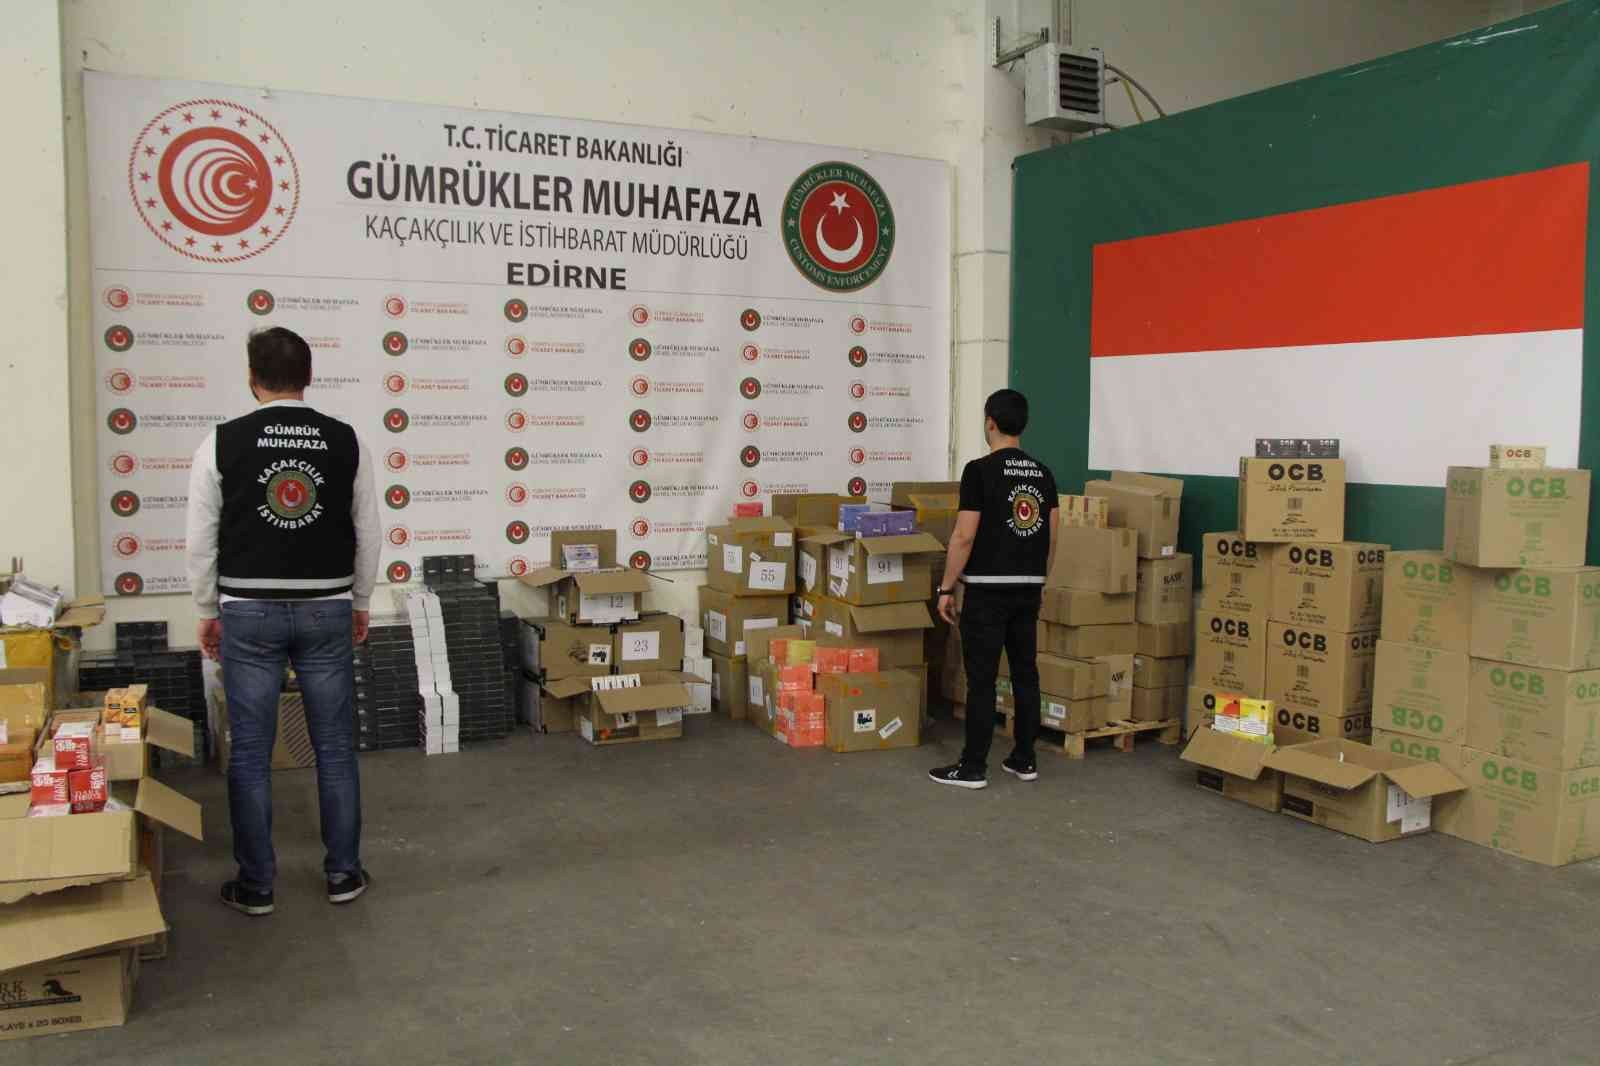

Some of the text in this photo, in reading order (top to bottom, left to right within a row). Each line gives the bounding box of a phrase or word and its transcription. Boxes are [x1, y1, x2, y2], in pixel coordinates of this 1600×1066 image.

[444, 123, 683, 168] T.C. TİCARET BAKANLIĞI
[346, 153, 762, 228] GÜMRÜKLER MUHAFAZA
[365, 214, 748, 261] KAÇAKÇILIK VE İSTİHBARAT MÜDÜRLÜĞÜ
[507, 259, 626, 290] EDİRNE
[263, 423, 321, 437] GÜMRÜK
[256, 437, 329, 450] MUHAFAZA
[1507, 448, 1532, 458] OCB
[256, 458, 325, 487] KAÇAKÇILIK
[1003, 467, 1044, 478] MUHAFAZA
[1005, 457, 1037, 468] GÜMRÜK
[1268, 463, 1325, 481] OCB
[1505, 478, 1567, 498] OCB
[1217, 539, 1258, 558] OCB
[1289, 546, 1333, 567] OCB
[1357, 550, 1385, 564] OCB
[1403, 560, 1454, 583] OCB
[1493, 574, 1551, 597] OCB
[1210, 617, 1249, 638] OCB
[1283, 629, 1327, 651] OCB
[1489, 666, 1545, 695] OCB
[1277, 709, 1320, 733] OCB
[1343, 715, 1372, 733] OCB
[1391, 706, 1444, 733] OCB
[1390, 738, 1440, 761] OCB
[1481, 760, 1538, 791] OCB
